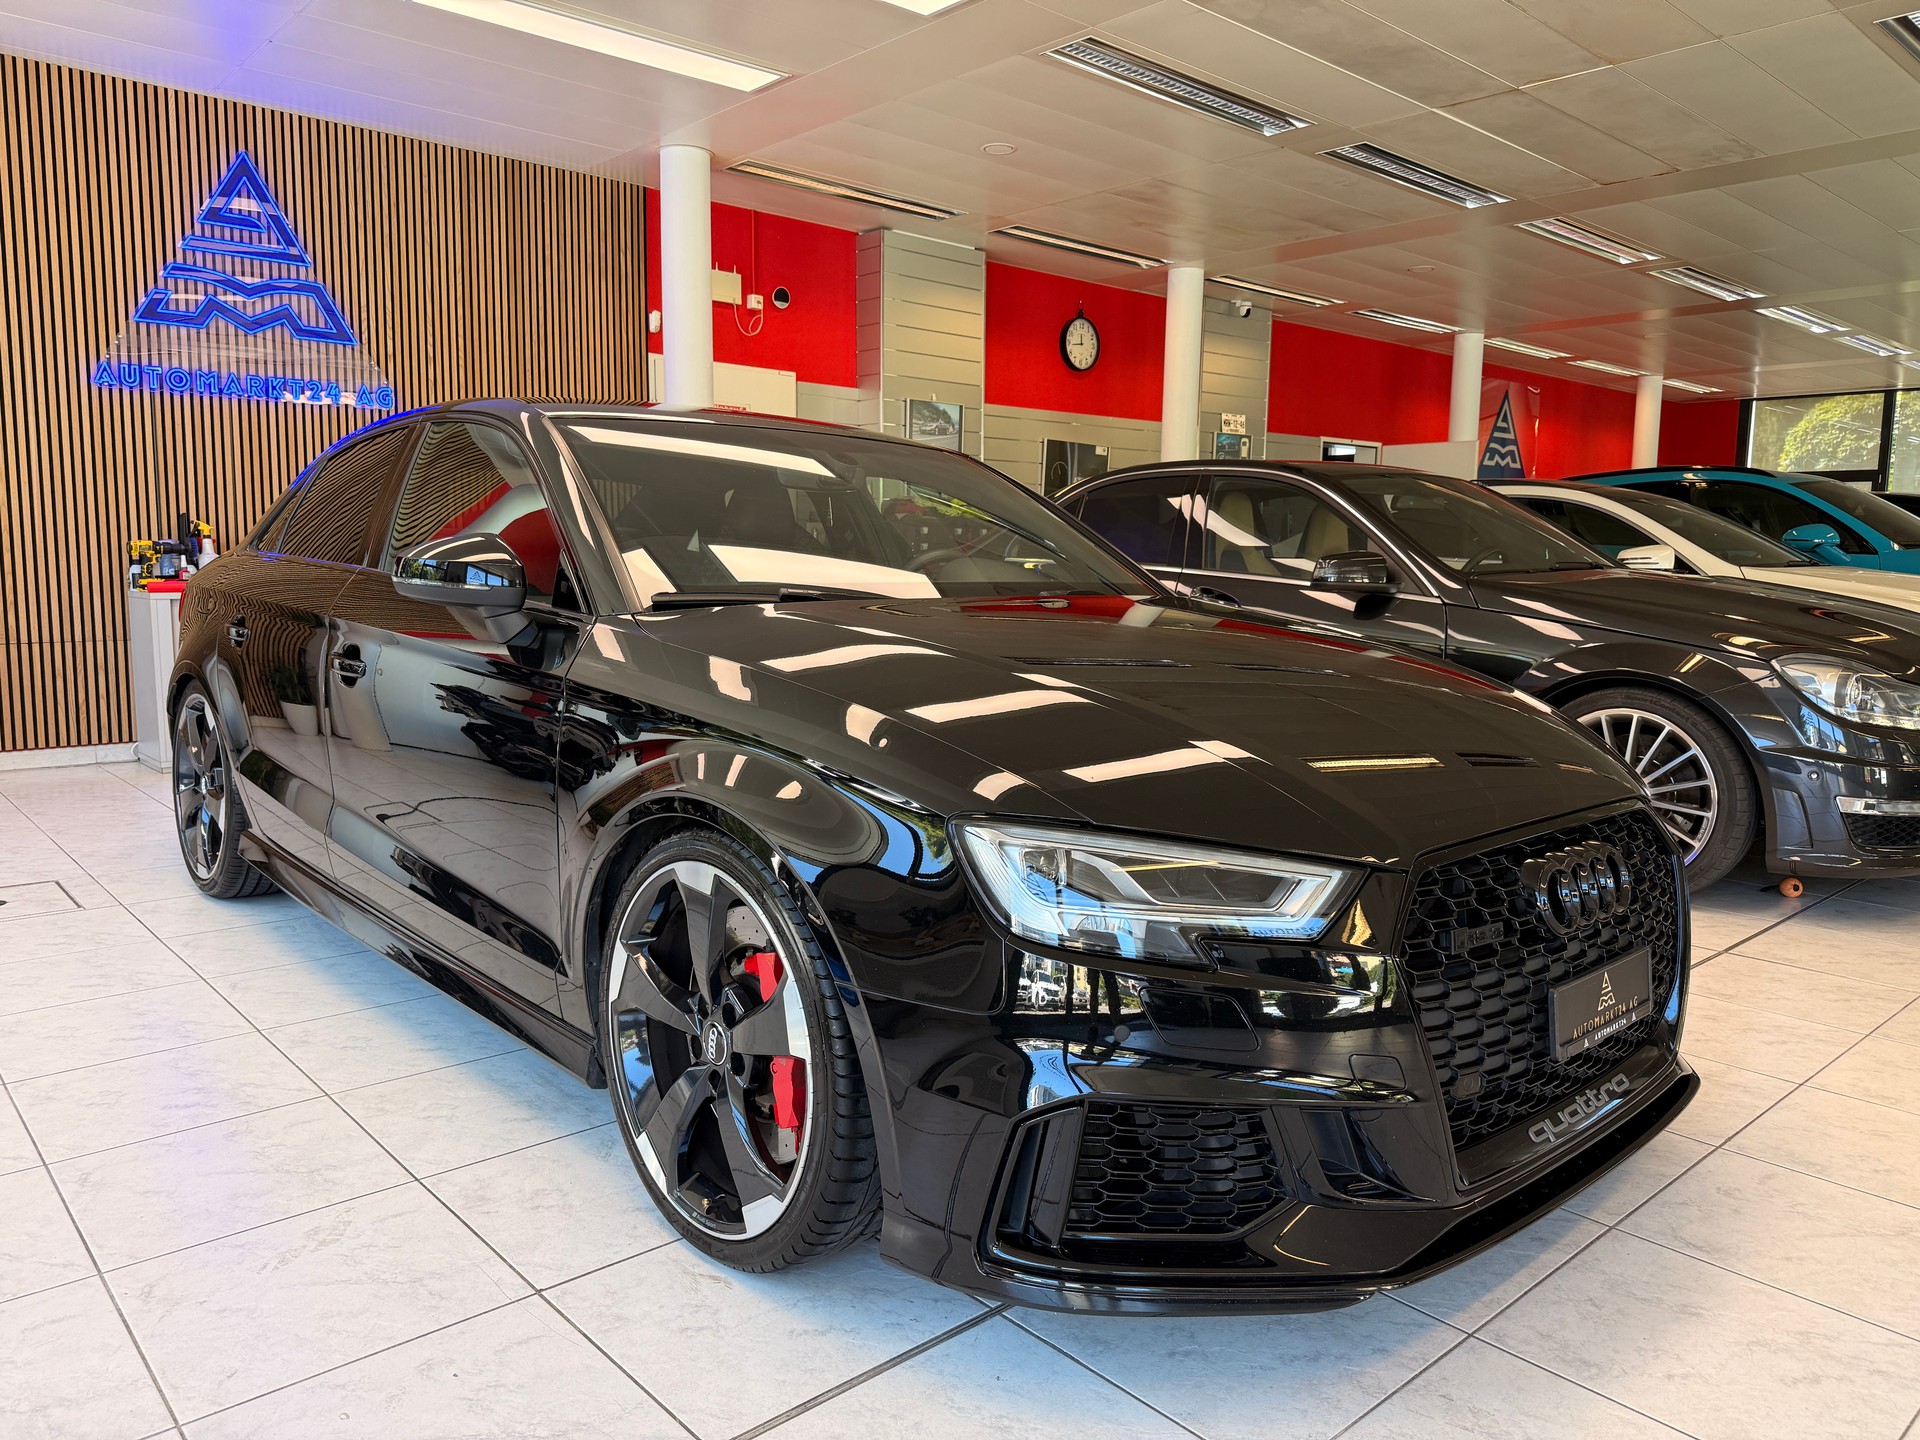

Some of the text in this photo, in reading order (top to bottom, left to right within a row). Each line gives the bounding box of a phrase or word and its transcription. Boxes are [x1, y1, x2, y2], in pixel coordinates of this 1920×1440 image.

[93, 360, 394, 409] AUTOMARKT24 AG
[1572, 995, 1638, 1040] AUTOMARKT24 AG
[1528, 1073, 1630, 1143] quattro
